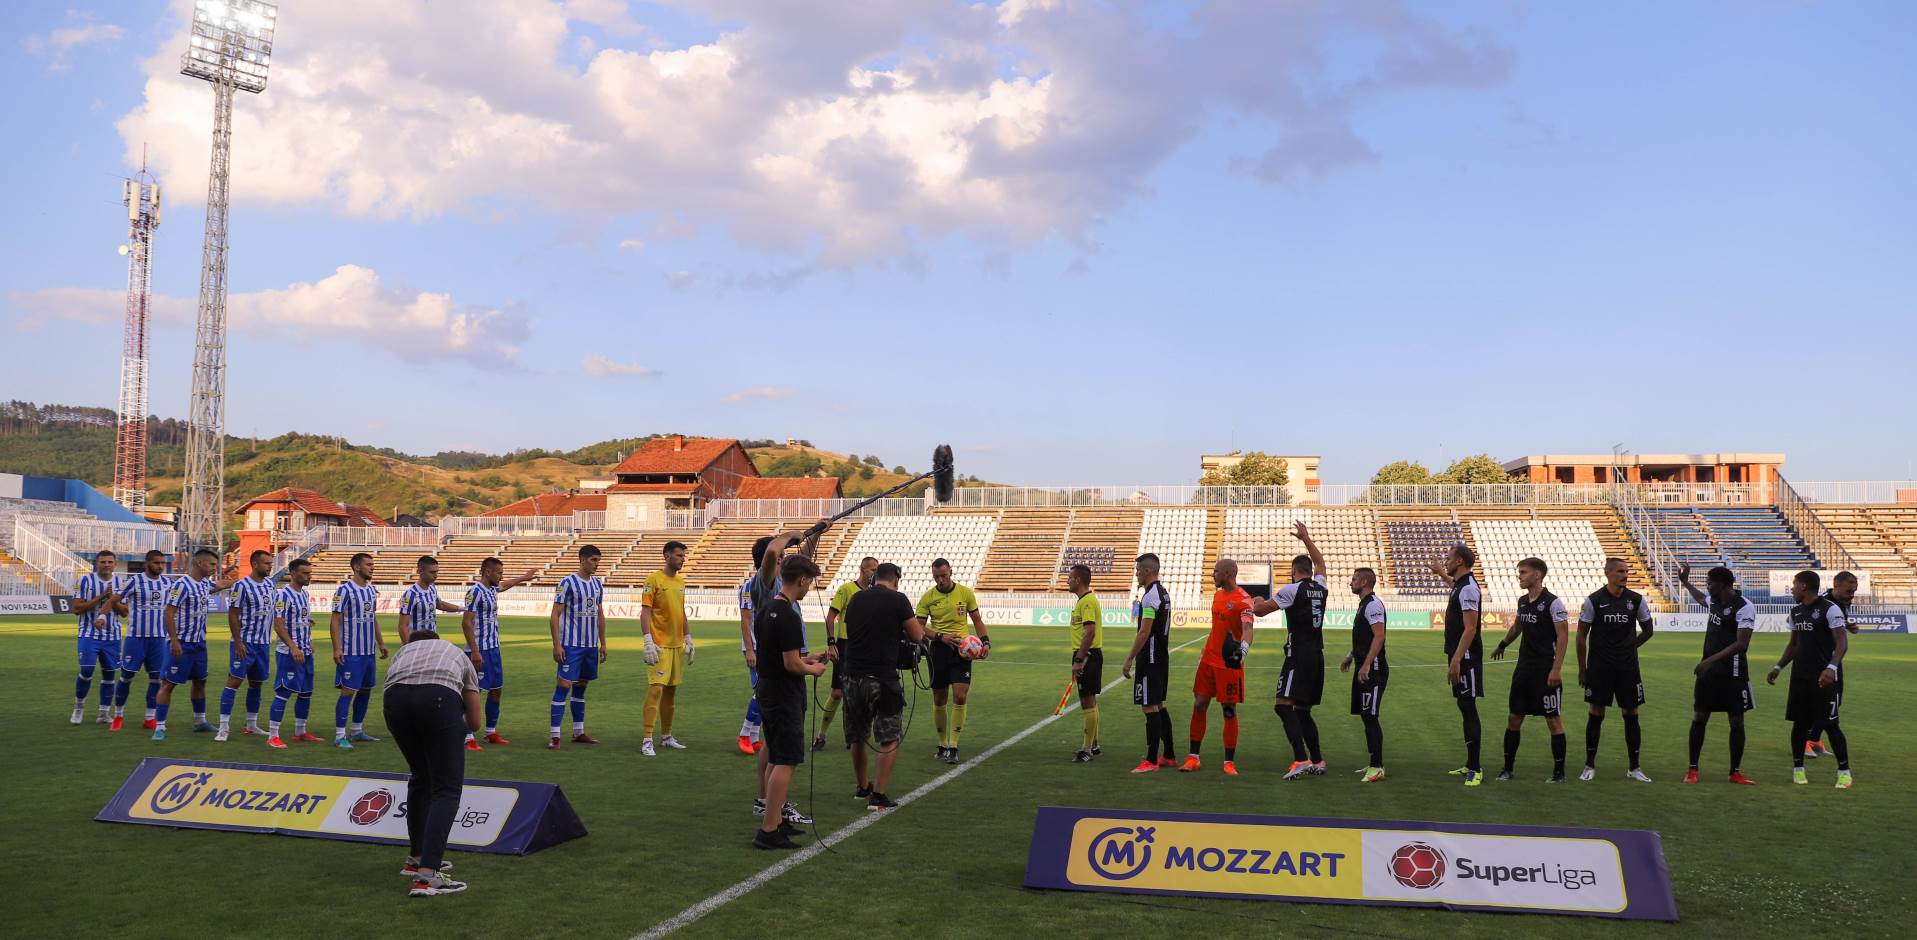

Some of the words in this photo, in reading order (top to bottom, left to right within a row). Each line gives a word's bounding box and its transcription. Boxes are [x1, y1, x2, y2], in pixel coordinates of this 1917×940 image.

[1, 603, 22, 611] NOVI
[23, 603, 48, 611] PAZAR
[1311, 600, 1322, 628] 5
[1520, 612, 1537, 624] mts
[1603, 612, 1629, 623] mts
[1797, 620, 1814, 631] mts
[1135, 683, 1143, 697] 12
[1226, 682, 1240, 696] 85
[1362, 692, 1372, 707] 17
[1543, 695, 1557, 709] 90
[1742, 689, 1748, 704] 9
[1829, 701, 1836, 716] 7
[200, 788, 328, 815] MOZZART
[1164, 846, 1345, 878] MOZZART
[1456, 857, 1597, 890] SuperLiga
